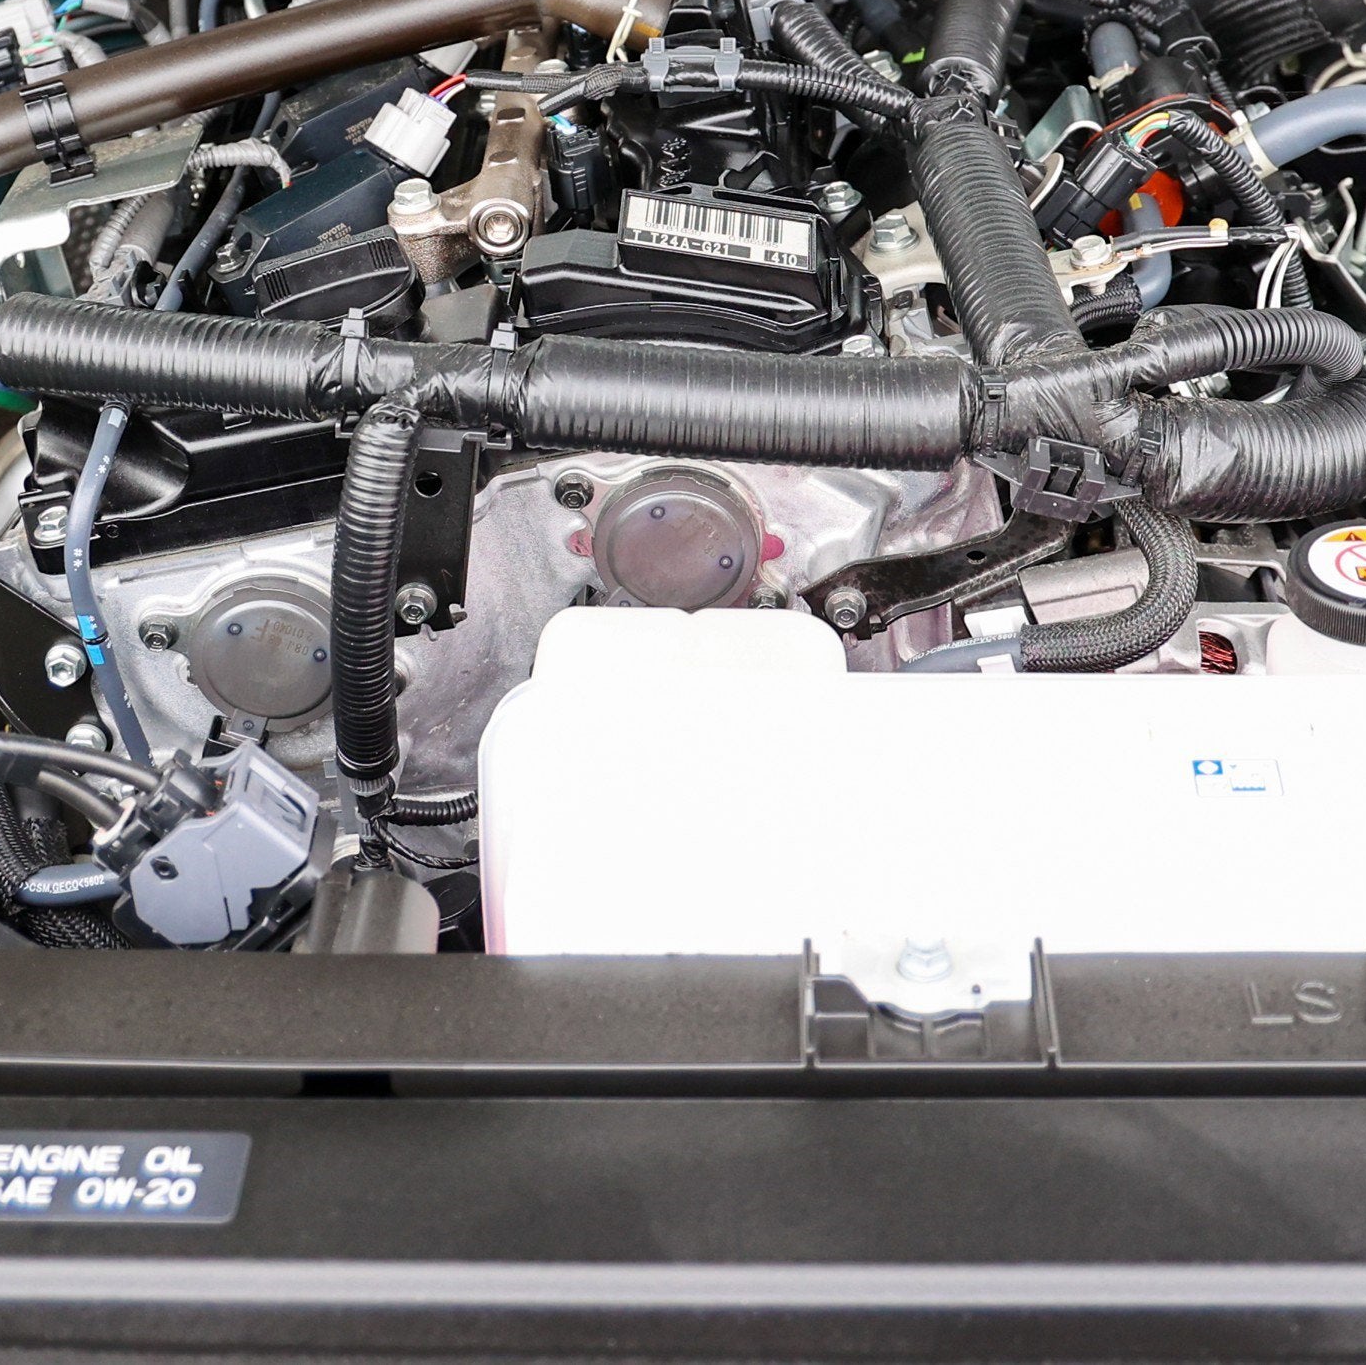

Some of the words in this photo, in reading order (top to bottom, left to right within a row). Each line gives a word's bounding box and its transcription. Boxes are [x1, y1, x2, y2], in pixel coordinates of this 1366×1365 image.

[317, 222, 347, 242] TOYOTA
[632, 230, 642, 242] T
[650, 232, 730, 256] T24A-G21
[771, 253, 798, 267] 410
[1244, 980, 1342, 1025] LS
[143, 1145, 204, 1174] OIL
[74, 1176, 198, 1207] 0W-20
